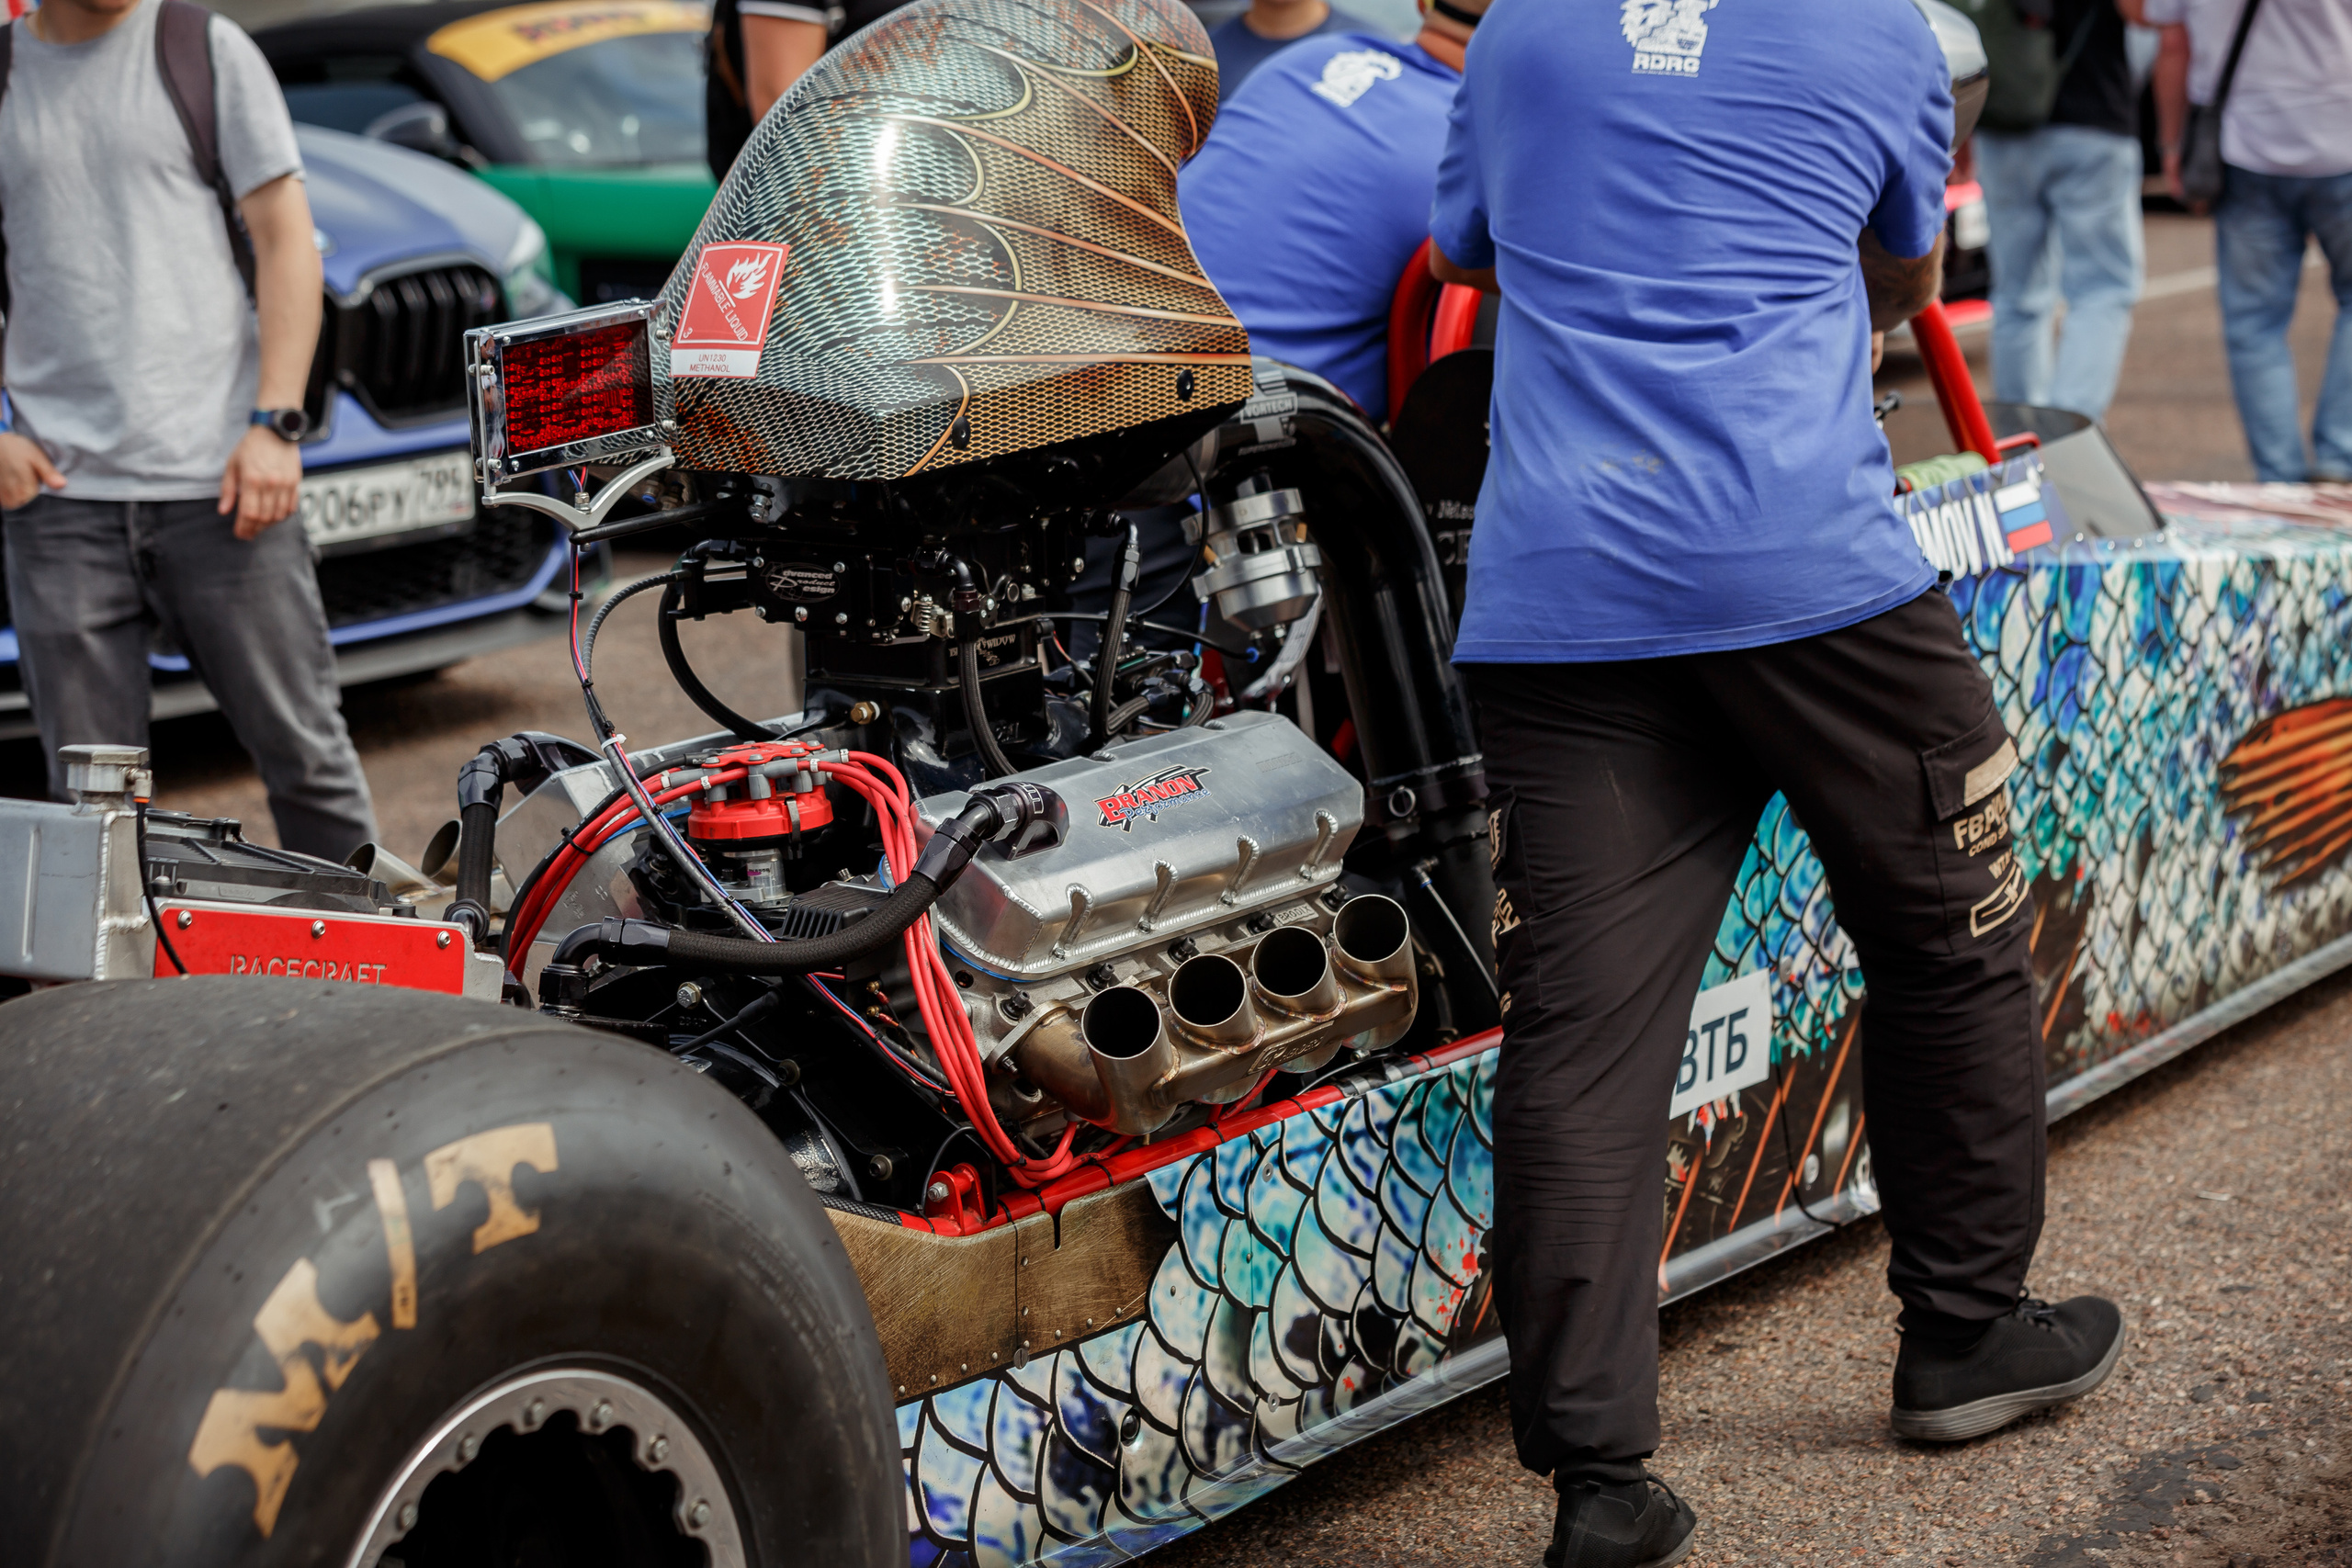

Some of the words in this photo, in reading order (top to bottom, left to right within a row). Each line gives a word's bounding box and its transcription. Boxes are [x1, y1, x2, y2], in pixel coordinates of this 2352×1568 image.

[1633, 52, 1701, 73] RDRC
[700, 262, 731, 313] FLAMMABLE
[725, 310, 749, 342] LIQUID
[683, 327, 694, 339] 3
[689, 364, 731, 373] METHANOL
[698, 354, 727, 363] UN1230
[1245, 398, 1293, 418] VORTECH
[986, 633, 1016, 649] WIDOW
[1097, 774, 1199, 823] BRANON
[1119, 788, 1211, 821] Performance
[1278, 905, 1312, 921] BRODIX
[1676, 1006, 1749, 1095] ВТБ
[188, 1122, 559, 1540] M/T
